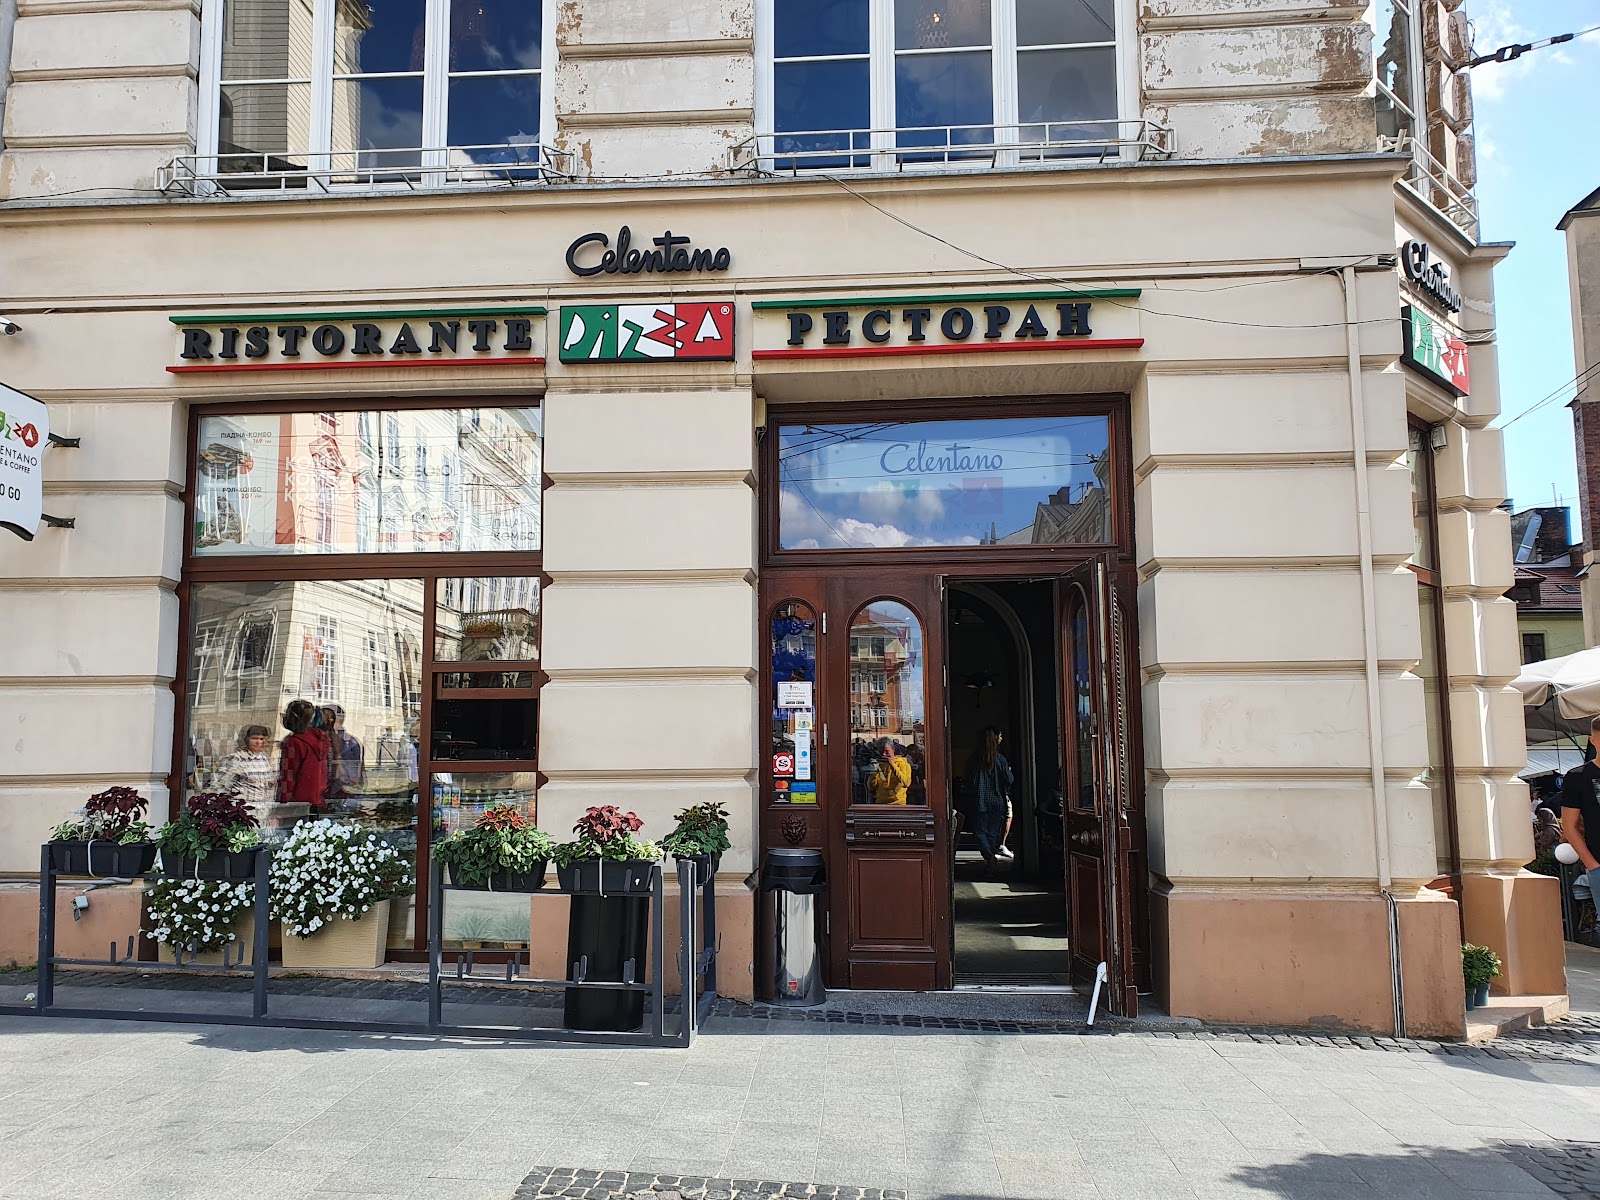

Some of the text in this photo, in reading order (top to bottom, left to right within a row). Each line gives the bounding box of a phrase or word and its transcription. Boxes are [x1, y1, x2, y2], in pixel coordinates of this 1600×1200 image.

[565, 225, 731, 277] Celentano
[181, 319, 532, 359] RISTORANTE
[786, 302, 1093, 346] РЕСТОРАН
[9, 461, 31, 475] COFFEE
[880, 438, 1004, 474] Celentano
[8, 486, 21, 501] GO
